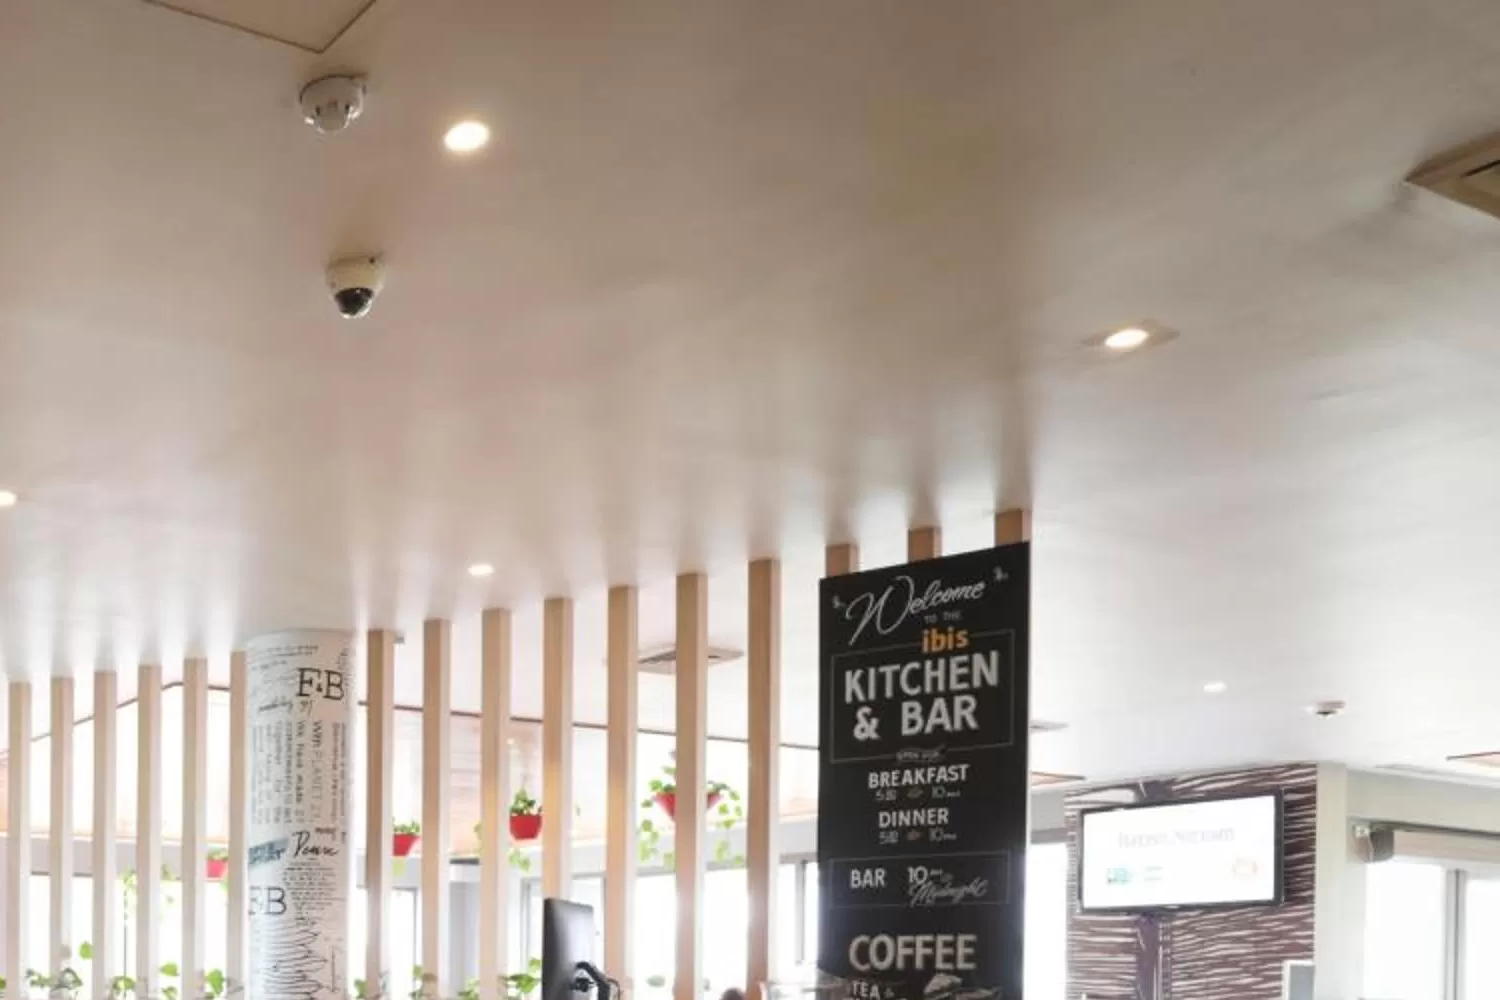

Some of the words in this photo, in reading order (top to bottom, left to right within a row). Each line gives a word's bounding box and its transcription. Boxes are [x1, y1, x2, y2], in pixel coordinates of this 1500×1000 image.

[845, 575, 986, 646] Welcome
[922, 626, 969, 653] ibis
[845, 649, 1000, 704] KITCHEN
[853, 705, 881, 741] &
[900, 694, 979, 737] BAR
[868, 764, 970, 789] BREAKFAST
[878, 807, 949, 829] DINNER
[850, 868, 887, 889] BAR
[849, 934, 977, 971] COFFEE
[852, 980, 881, 1000] TEA
